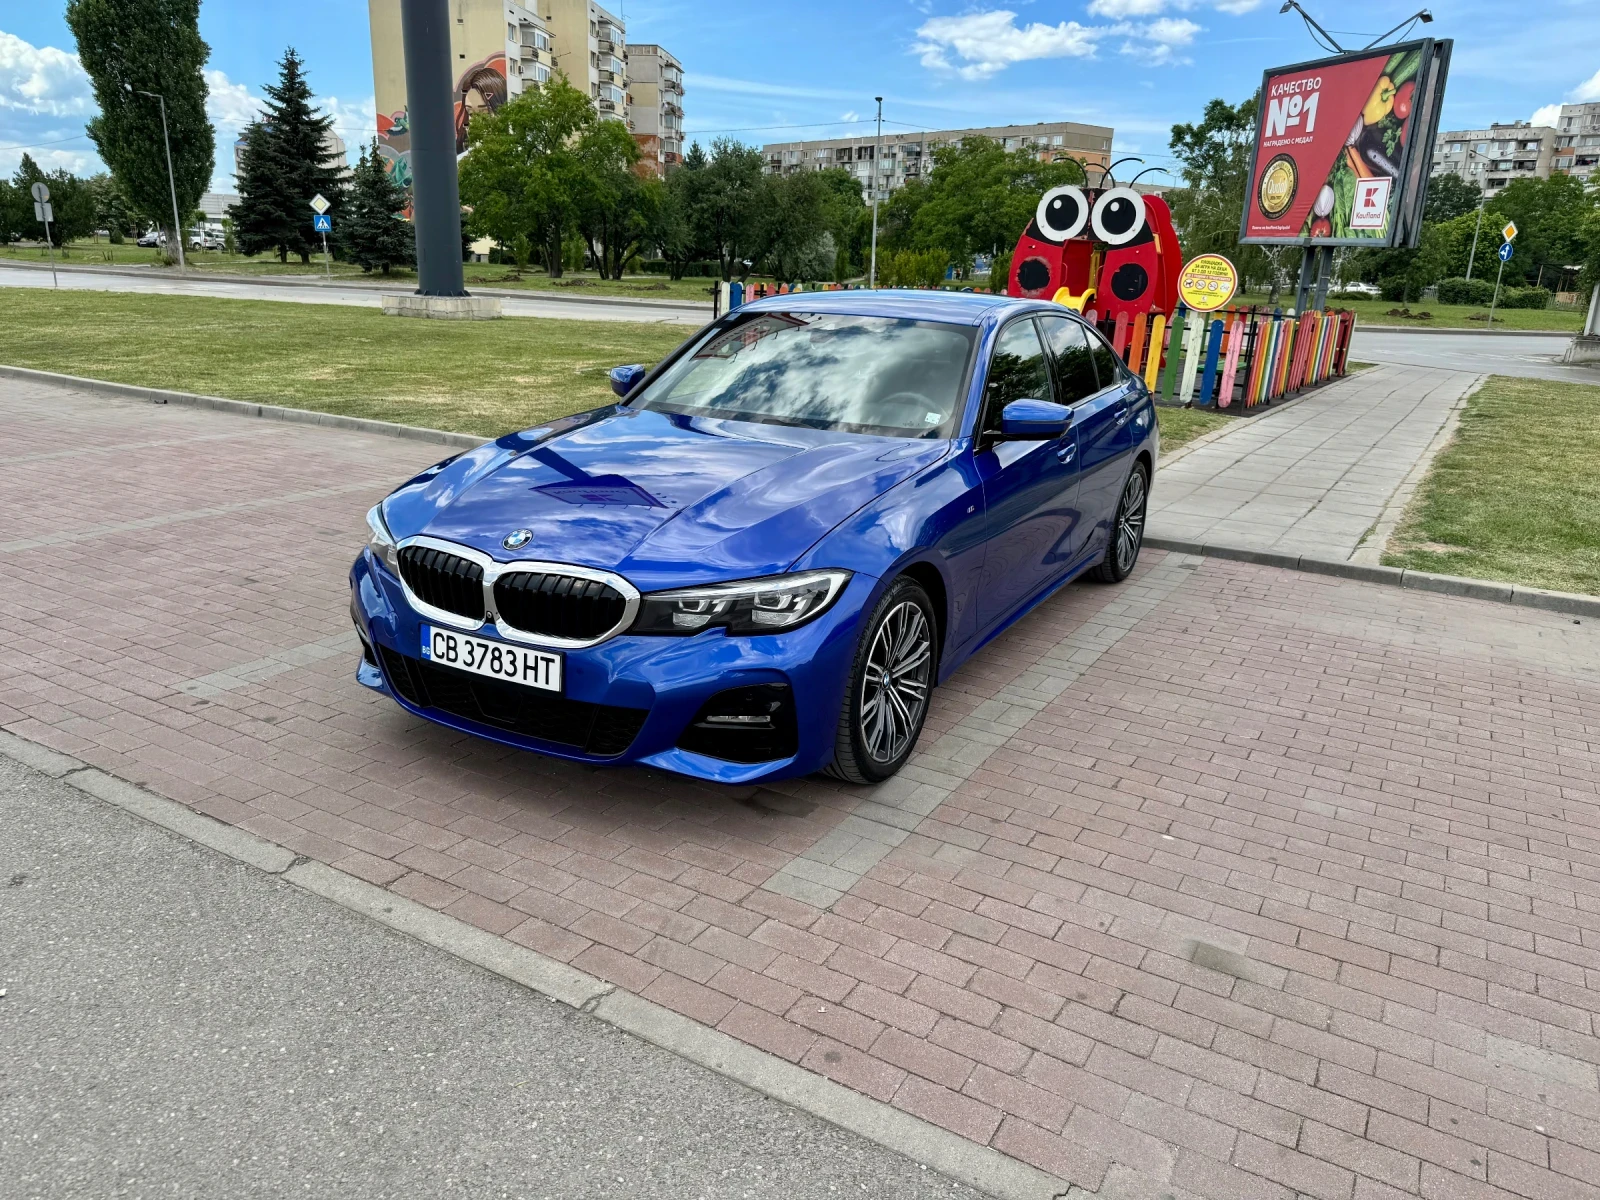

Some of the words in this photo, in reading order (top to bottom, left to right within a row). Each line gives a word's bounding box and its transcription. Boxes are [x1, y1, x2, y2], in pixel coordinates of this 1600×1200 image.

[1271, 77, 1322, 97] КАЧЕСТВО
[1263, 139, 1290, 147] НАГРАДЕНО
[1295, 136, 1313, 144] МЕДАЛ
[422, 645, 431, 655] BG
[433, 632, 458, 663] CB
[463, 640, 518, 677] 3783
[523, 653, 555, 685] HT
